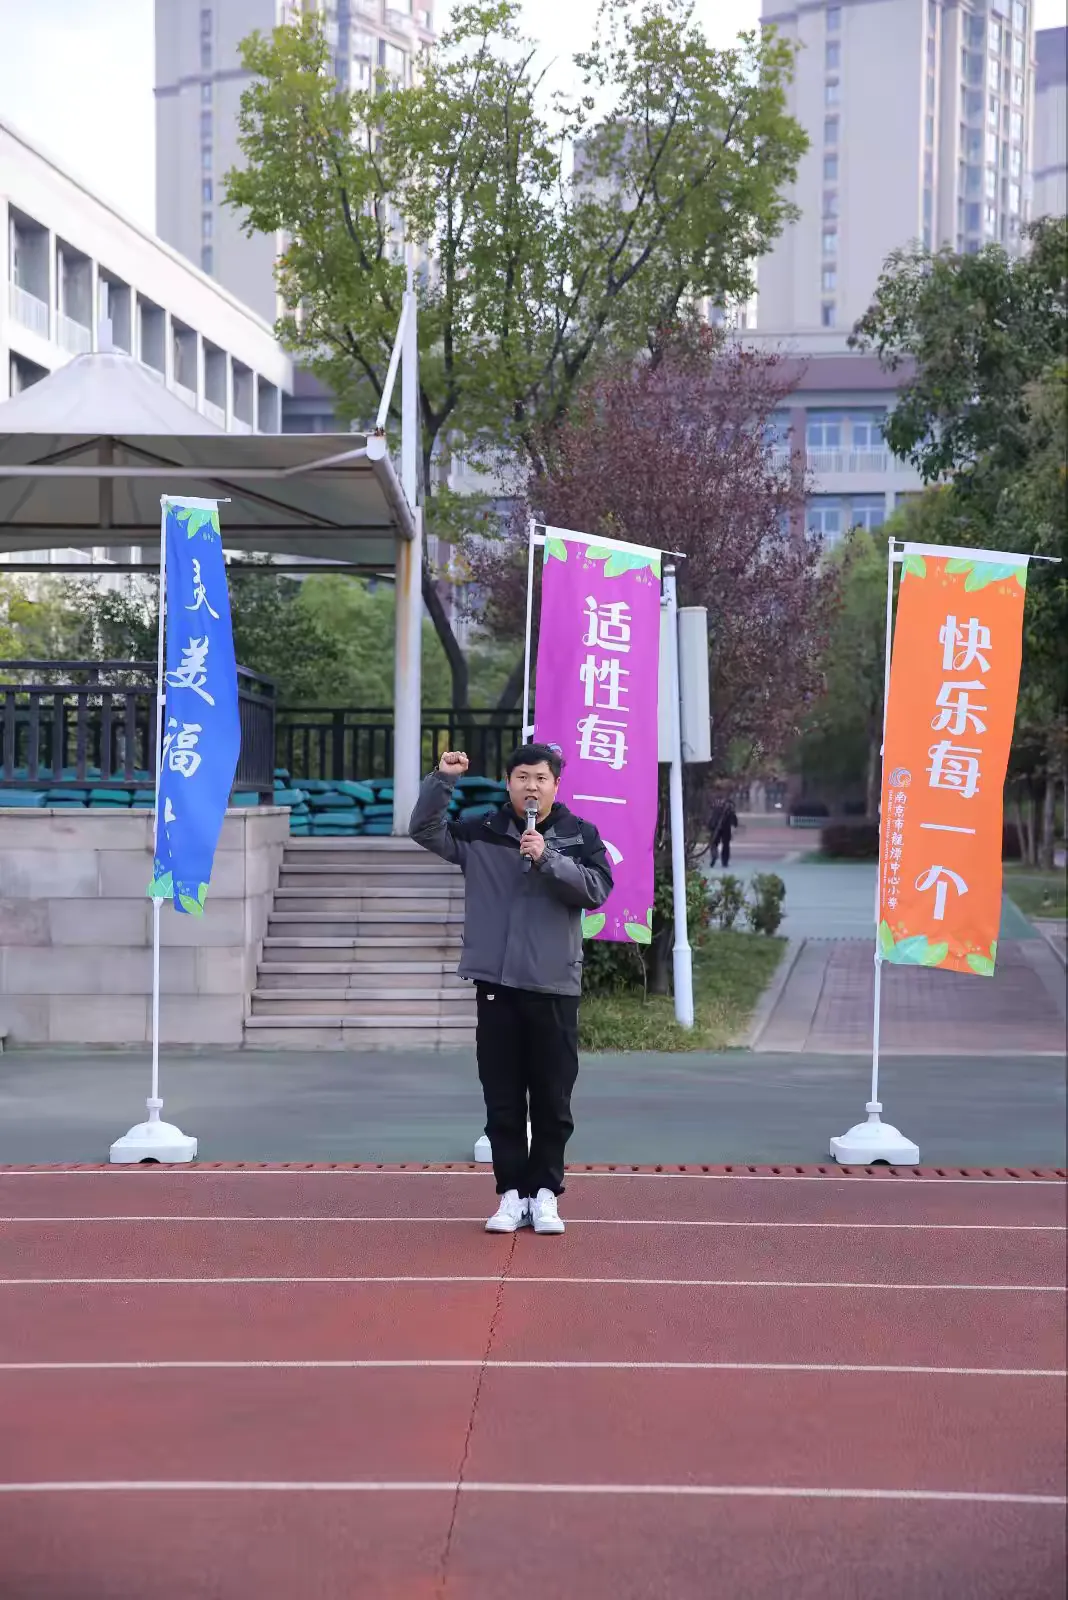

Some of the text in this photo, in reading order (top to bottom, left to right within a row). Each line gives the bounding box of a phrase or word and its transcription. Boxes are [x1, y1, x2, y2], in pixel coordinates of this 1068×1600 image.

[914, 614, 993, 920] 快乐每一个
